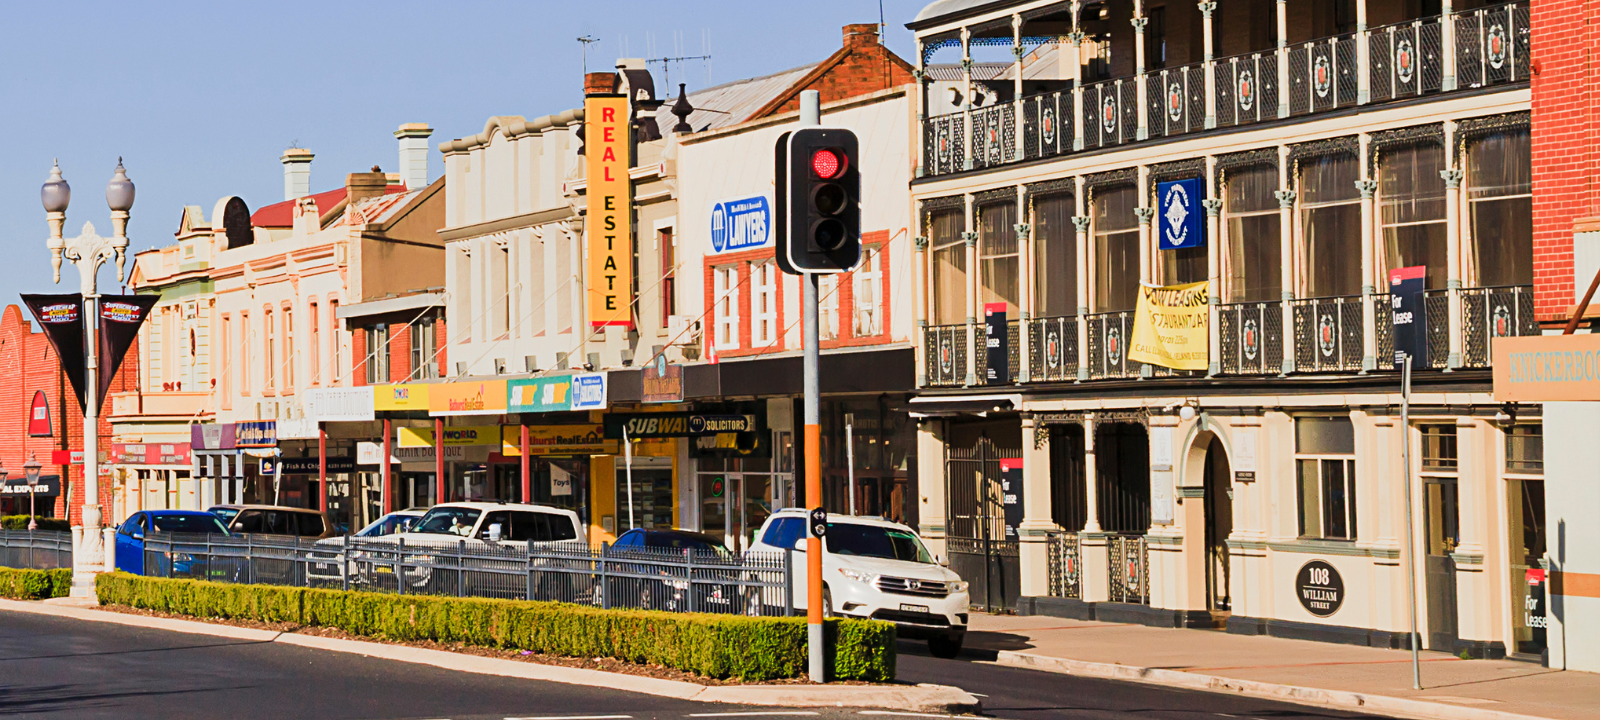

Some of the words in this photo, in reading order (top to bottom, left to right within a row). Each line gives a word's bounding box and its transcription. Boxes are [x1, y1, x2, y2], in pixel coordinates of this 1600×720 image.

[602, 107, 616, 182] REAL
[729, 210, 766, 247] LAWYERS
[604, 196, 617, 310] ESTATE
[1168, 288, 1208, 307] LEASING
[1391, 294, 1402, 309] For
[42, 304, 76, 312] SUPERCHEAP
[105, 302, 140, 311] SUPERCHEAP
[1392, 310, 1413, 325] Lease
[706, 420, 745, 431] SOLICITORS
[431, 430, 477, 439] TYWORLD
[518, 432, 604, 445] BthurstRealEstate
[422, 446, 462, 457] BOIQUE
[14, 485, 49, 493] EXPRTS
[553, 479, 569, 487] Toys
[1309, 567, 1330, 585] 108
[1302, 589, 1337, 602] WILLIAM
[1525, 594, 1538, 610] For
[1310, 601, 1330, 609] STREET
[1525, 612, 1548, 629] Lease
